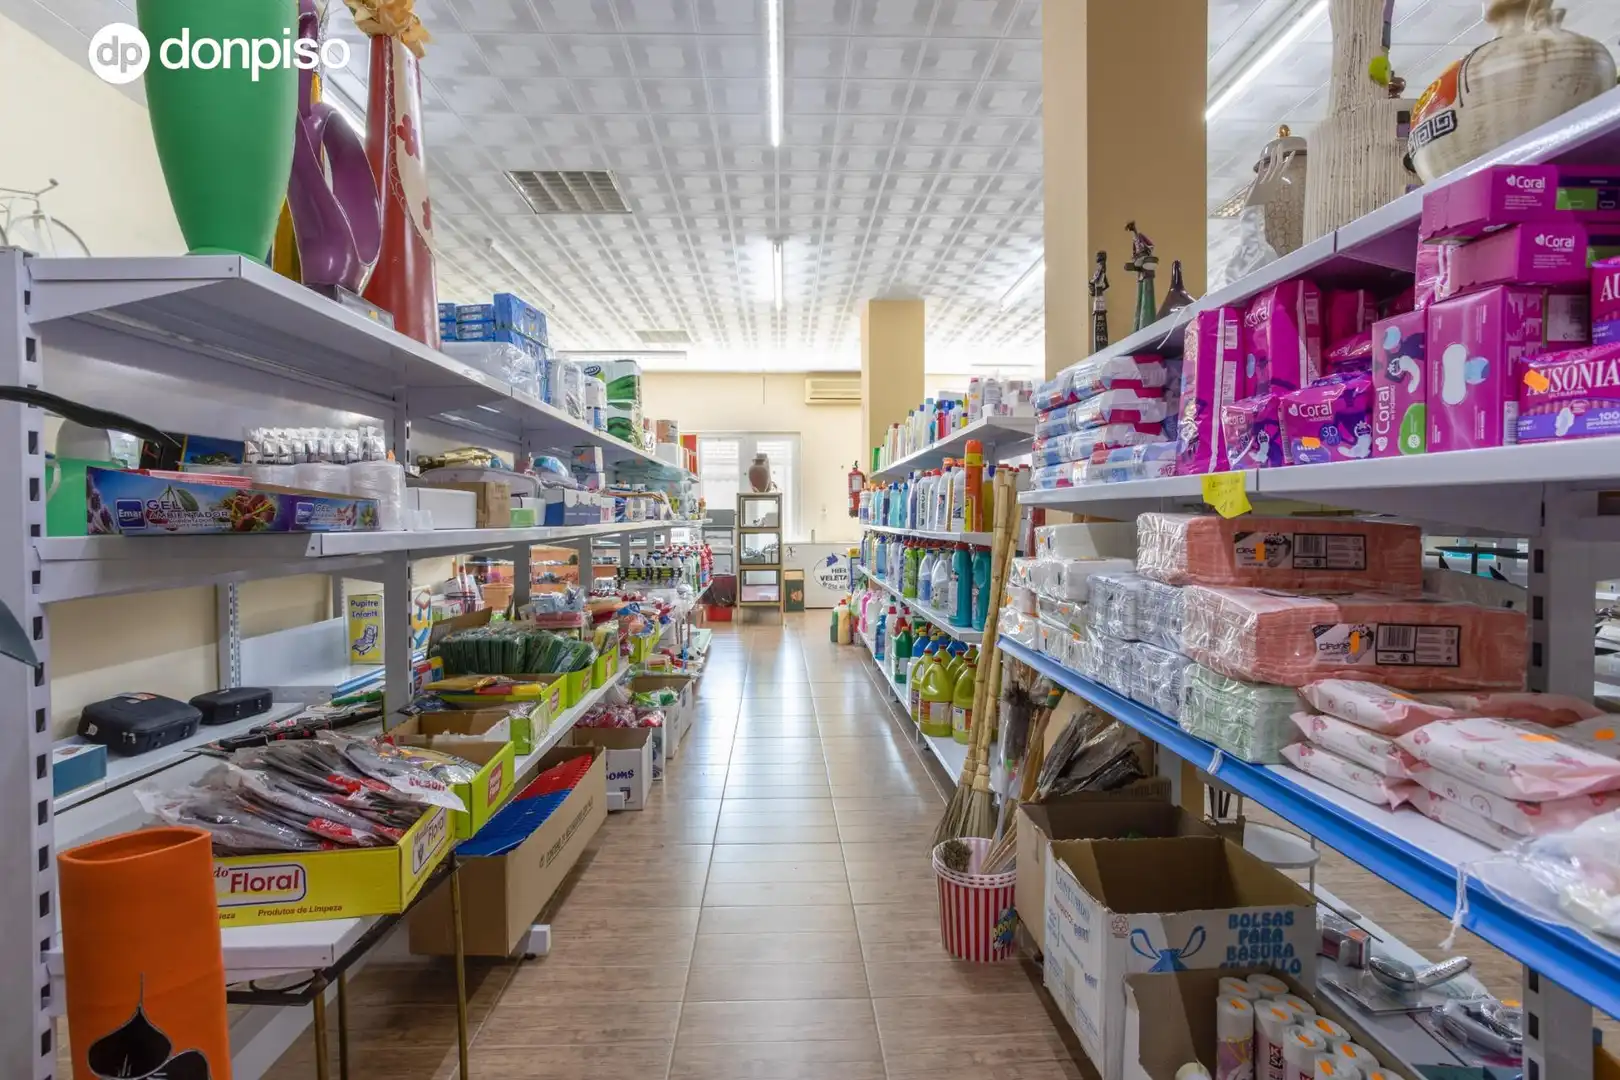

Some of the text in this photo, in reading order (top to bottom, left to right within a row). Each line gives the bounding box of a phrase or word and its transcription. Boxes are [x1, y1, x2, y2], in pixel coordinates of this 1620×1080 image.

[1516, 176, 1546, 188] Coral
[1545, 235, 1575, 248] Coral
[1526, 358, 1620, 396] USONIA
[1299, 400, 1333, 418] Coral
[1376, 386, 1390, 434] Coral
[146, 499, 182, 510] GEL
[213, 867, 229, 878] do
[230, 869, 300, 893] Floral
[296, 906, 307, 914] de
[1228, 911, 1294, 930] BOLSAS
[1238, 927, 1284, 945] PARA
[1226, 943, 1294, 961] BASURA
